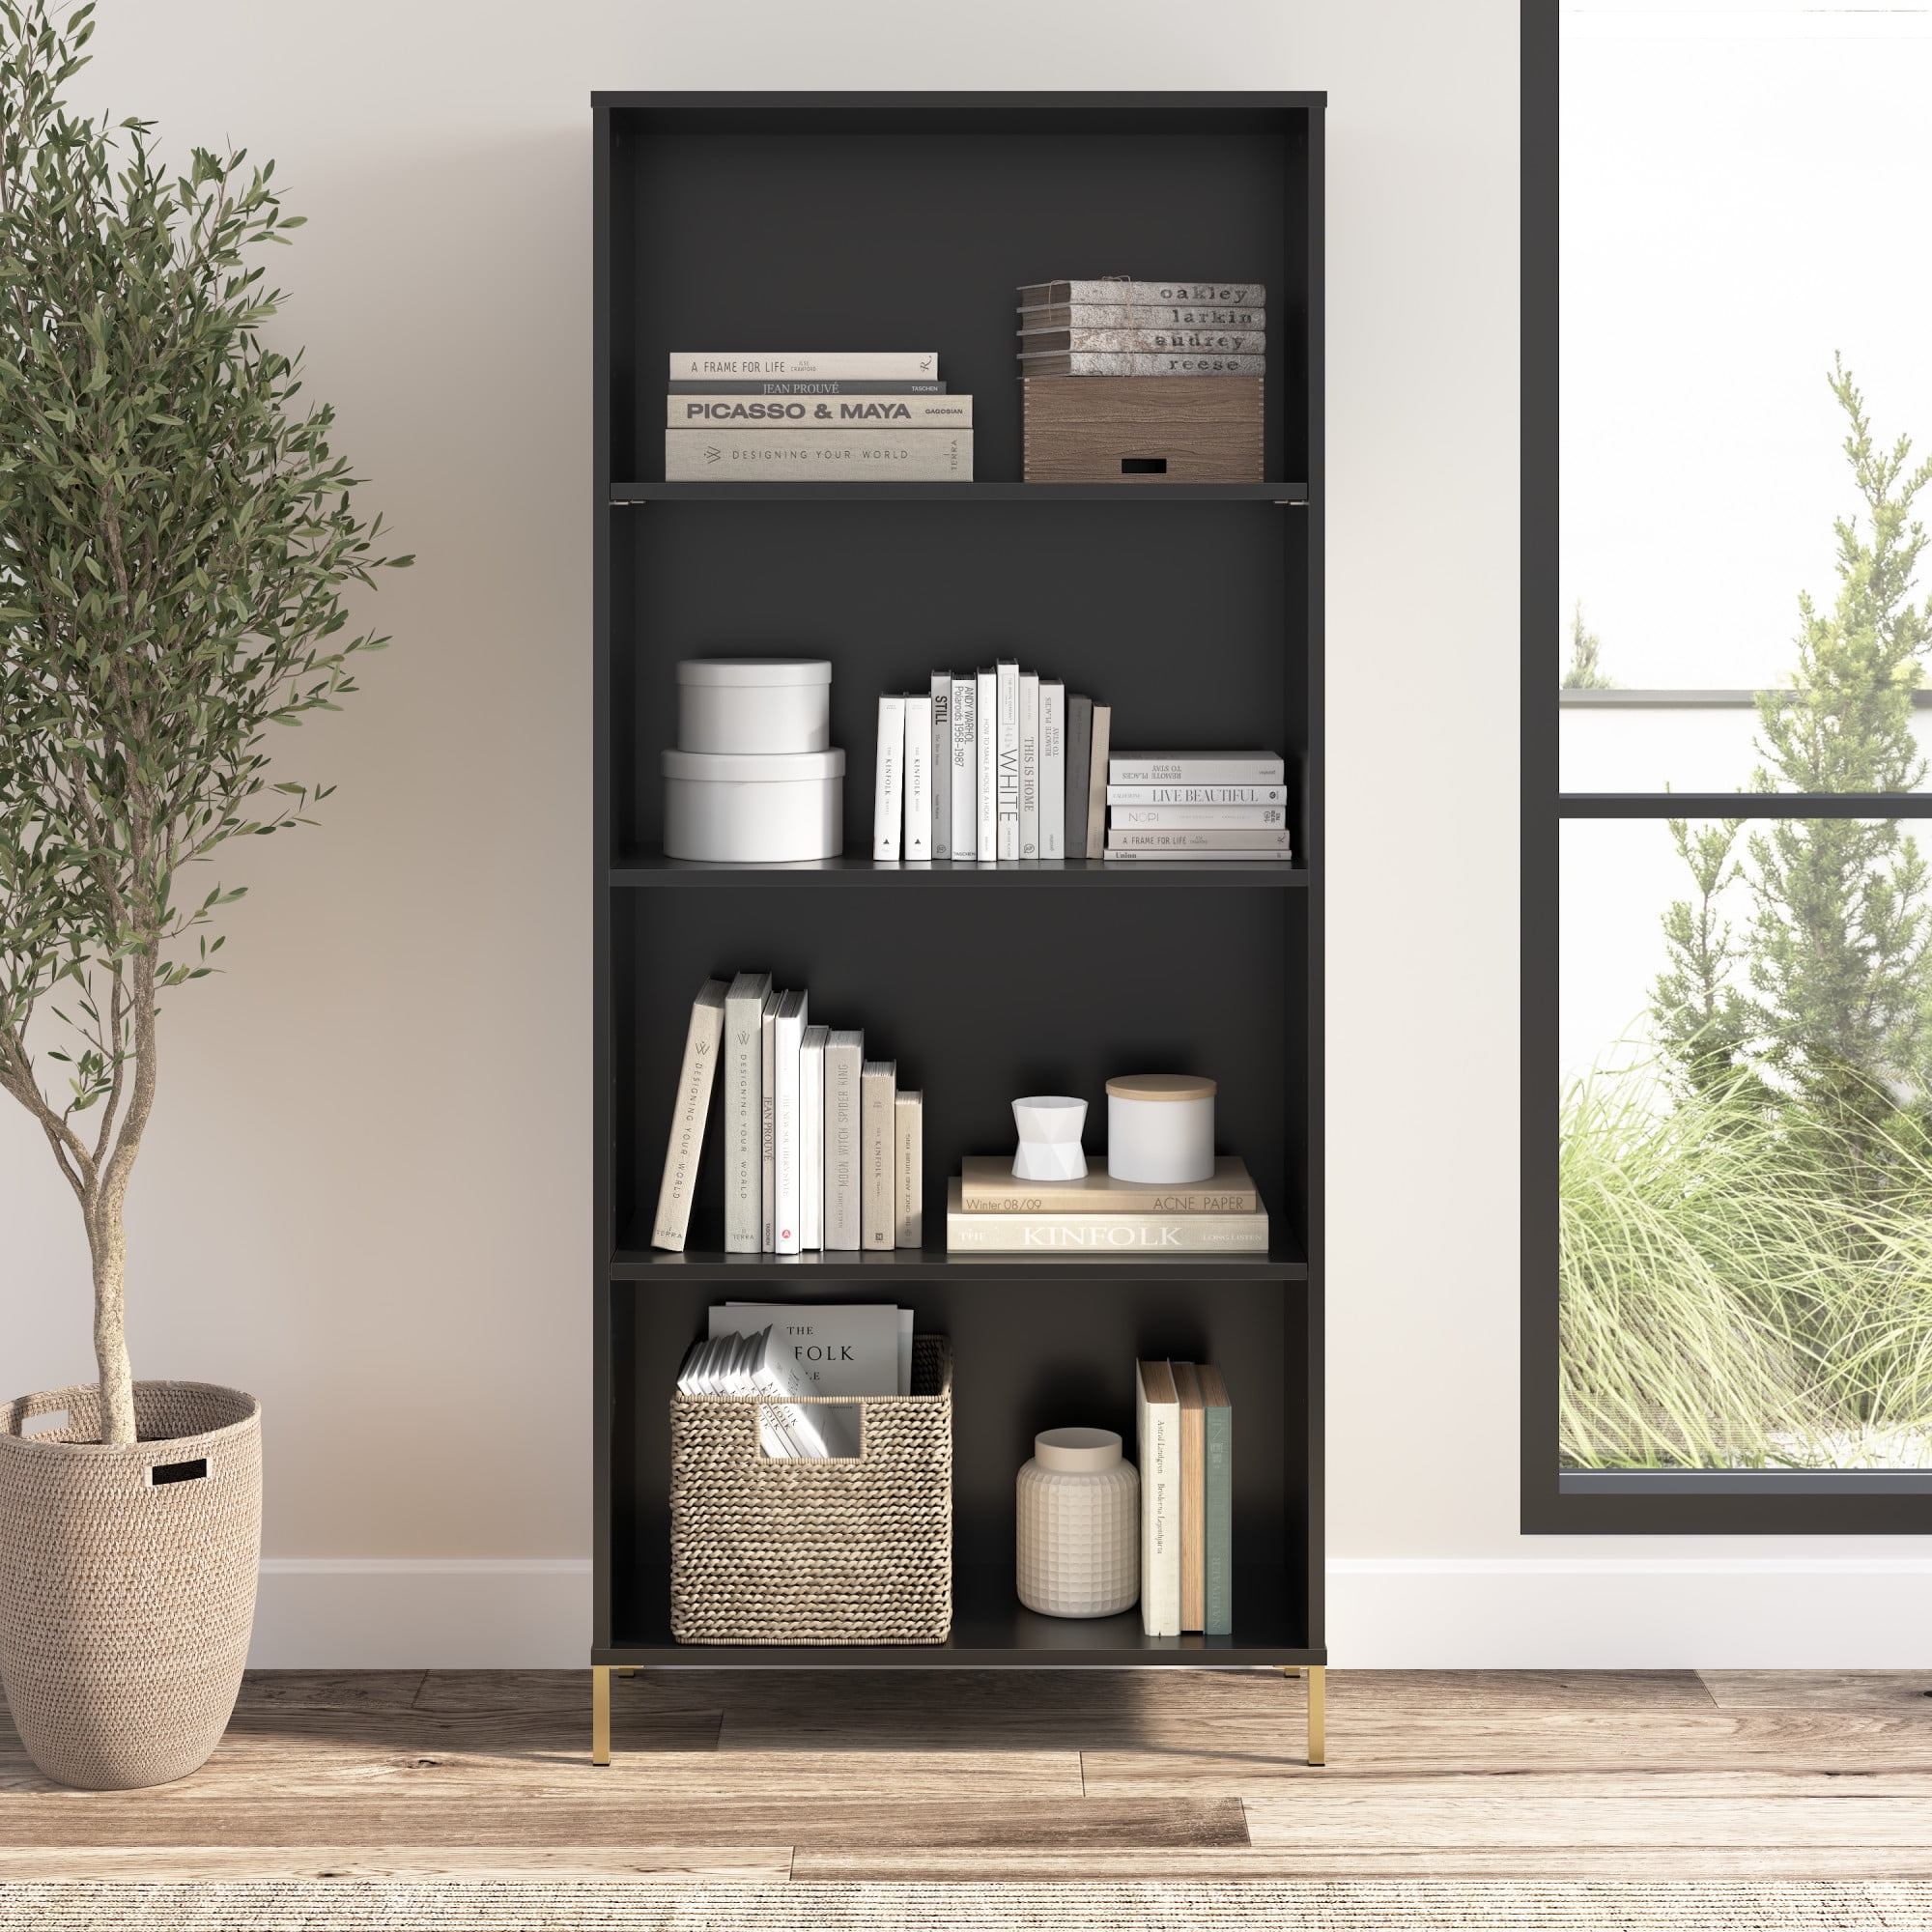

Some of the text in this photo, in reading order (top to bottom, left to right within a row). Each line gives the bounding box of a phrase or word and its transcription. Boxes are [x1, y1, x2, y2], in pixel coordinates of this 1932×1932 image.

[1160, 286, 1248, 303] oakley
[1172, 309, 1253, 324] larkin
[1154, 333, 1245, 349] audrey
[691, 362, 785, 372] A FRAME FOR LIFE
[1169, 360, 1240, 371] reese
[764, 382, 839, 395] JEAN PROUVÉ
[687, 403, 912, 419] PICASSO & MAYA
[733, 450, 908, 459] DESIGNING YOUR WORLD
[935, 696, 947, 725] STILL
[954, 686, 964, 721] Polaroids
[965, 686, 974, 745] ANDY WARHOL
[983, 737, 990, 745] TO
[1053, 746, 1059, 756] TO
[1024, 737, 1034, 812] THIS IS HOME
[1000, 749, 1017, 821] WHITE
[1153, 789, 1258, 802] LIVE BEAUTIFUL
[1129, 812, 1159, 822] NOPI
[1123, 837, 1128, 845] A
[1132, 837, 1154, 845] FRAME
[1158, 837, 1170, 845] FOR
[1173, 837, 1187, 845] LIFE
[838, 1064, 849, 1086] KING
[764, 1097, 772, 1119] JEAN
[838, 1091, 849, 1122] SPIDER
[673, 1063, 703, 1199] DESIGNING YOUR WORLD
[838, 1128, 849, 1156] WITCH
[838, 1161, 849, 1187] MOON
[966, 1199, 1042, 1211] Winter 08/09
[1153, 1197, 1244, 1210] ACNE PAPER
[656, 1229, 683, 1239] TERRA
[1023, 1227, 1183, 1245] KINFOLK
[786, 1326, 813, 1335] THE
[794, 1346, 854, 1361] FOLK
